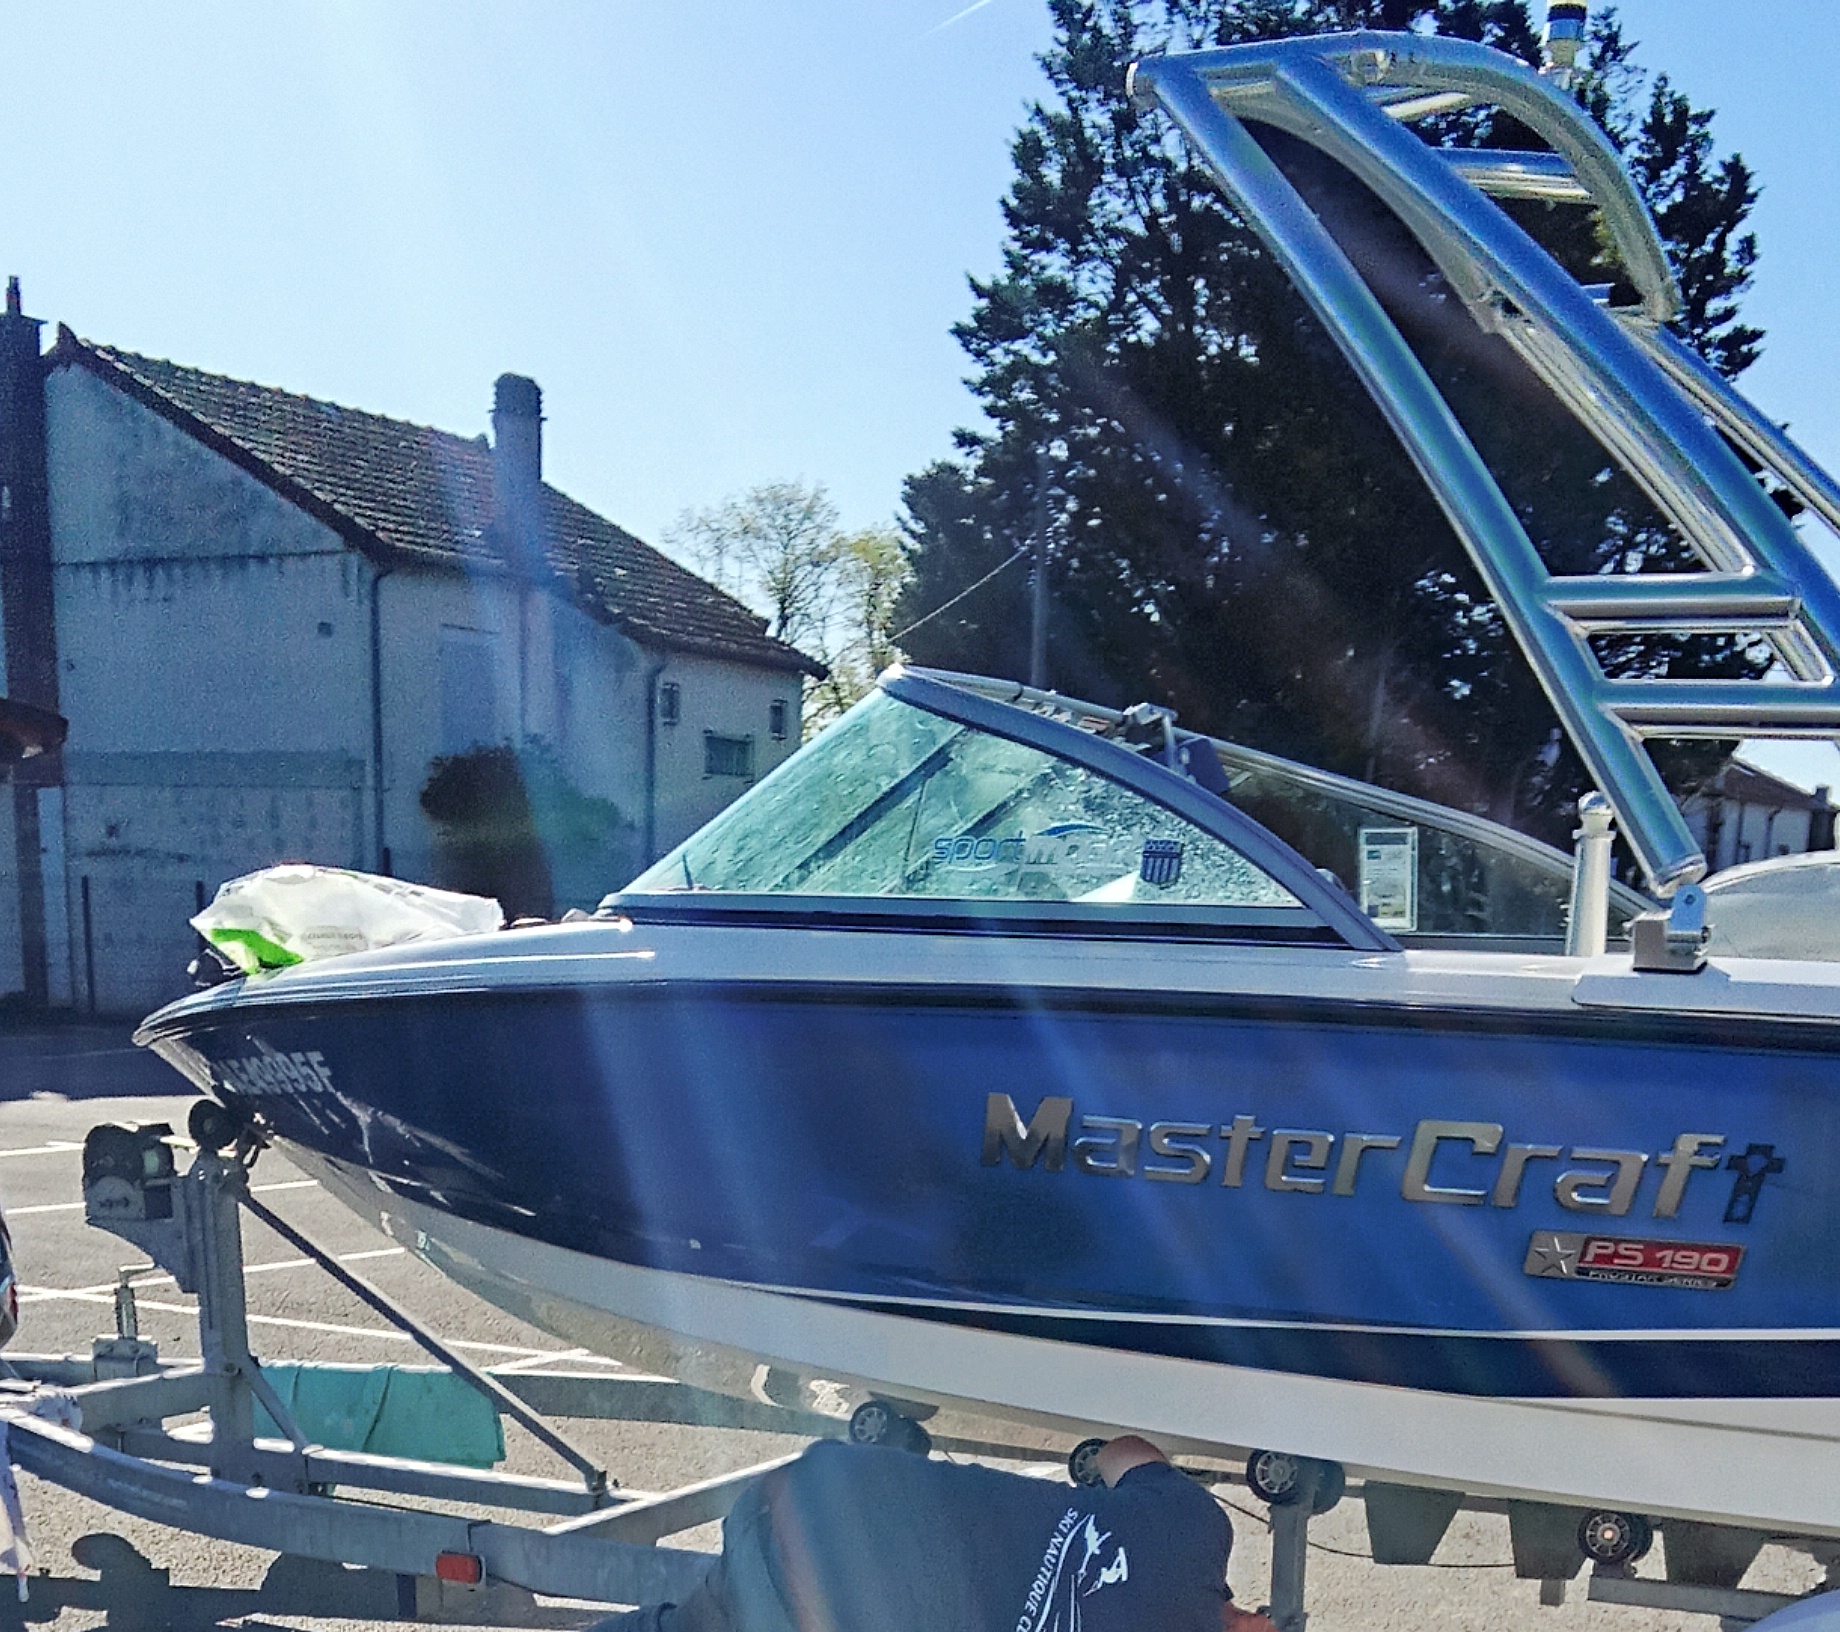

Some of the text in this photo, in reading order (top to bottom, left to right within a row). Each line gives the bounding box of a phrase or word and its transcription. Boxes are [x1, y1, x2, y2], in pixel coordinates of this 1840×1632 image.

[932, 831, 1026, 863] sport
[980, 1092, 1786, 1225] MasterCraft
[1585, 1240, 1730, 1273] PS 190
[1058, 1507, 1079, 1534] SKI
[1024, 1531, 1065, 1617] NAUTIQUE
